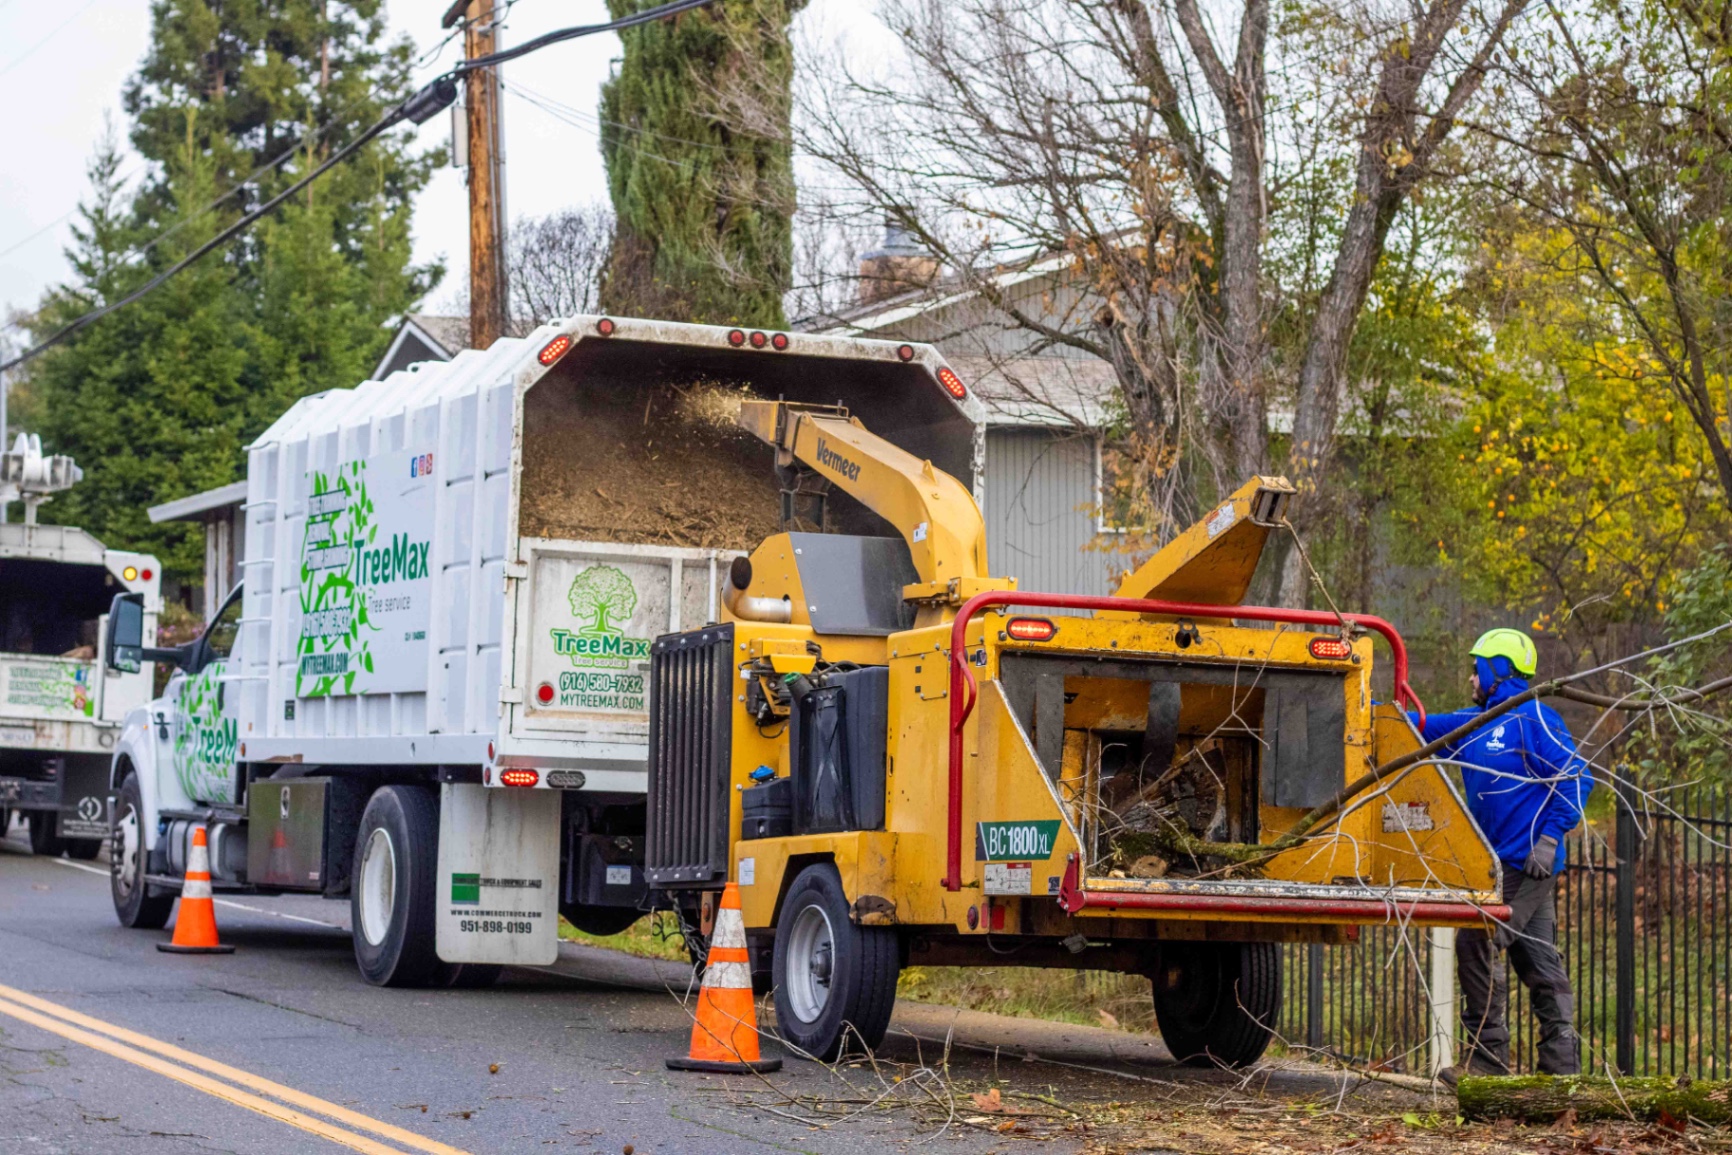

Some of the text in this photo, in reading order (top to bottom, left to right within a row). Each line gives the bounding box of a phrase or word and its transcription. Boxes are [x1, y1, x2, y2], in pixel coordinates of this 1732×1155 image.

[817, 437, 861, 482] Vermeer
[354, 532, 430, 587] TreeMax
[368, 595, 411, 614] Tree service
[553, 632, 648, 657] TreeMax
[574, 656, 627, 668] Tree service
[559, 671, 644, 694] (916) 580-7932
[560, 693, 644, 710] MYTREEMAX.COM
[460, 920, 533, 934] 951-898-0199
